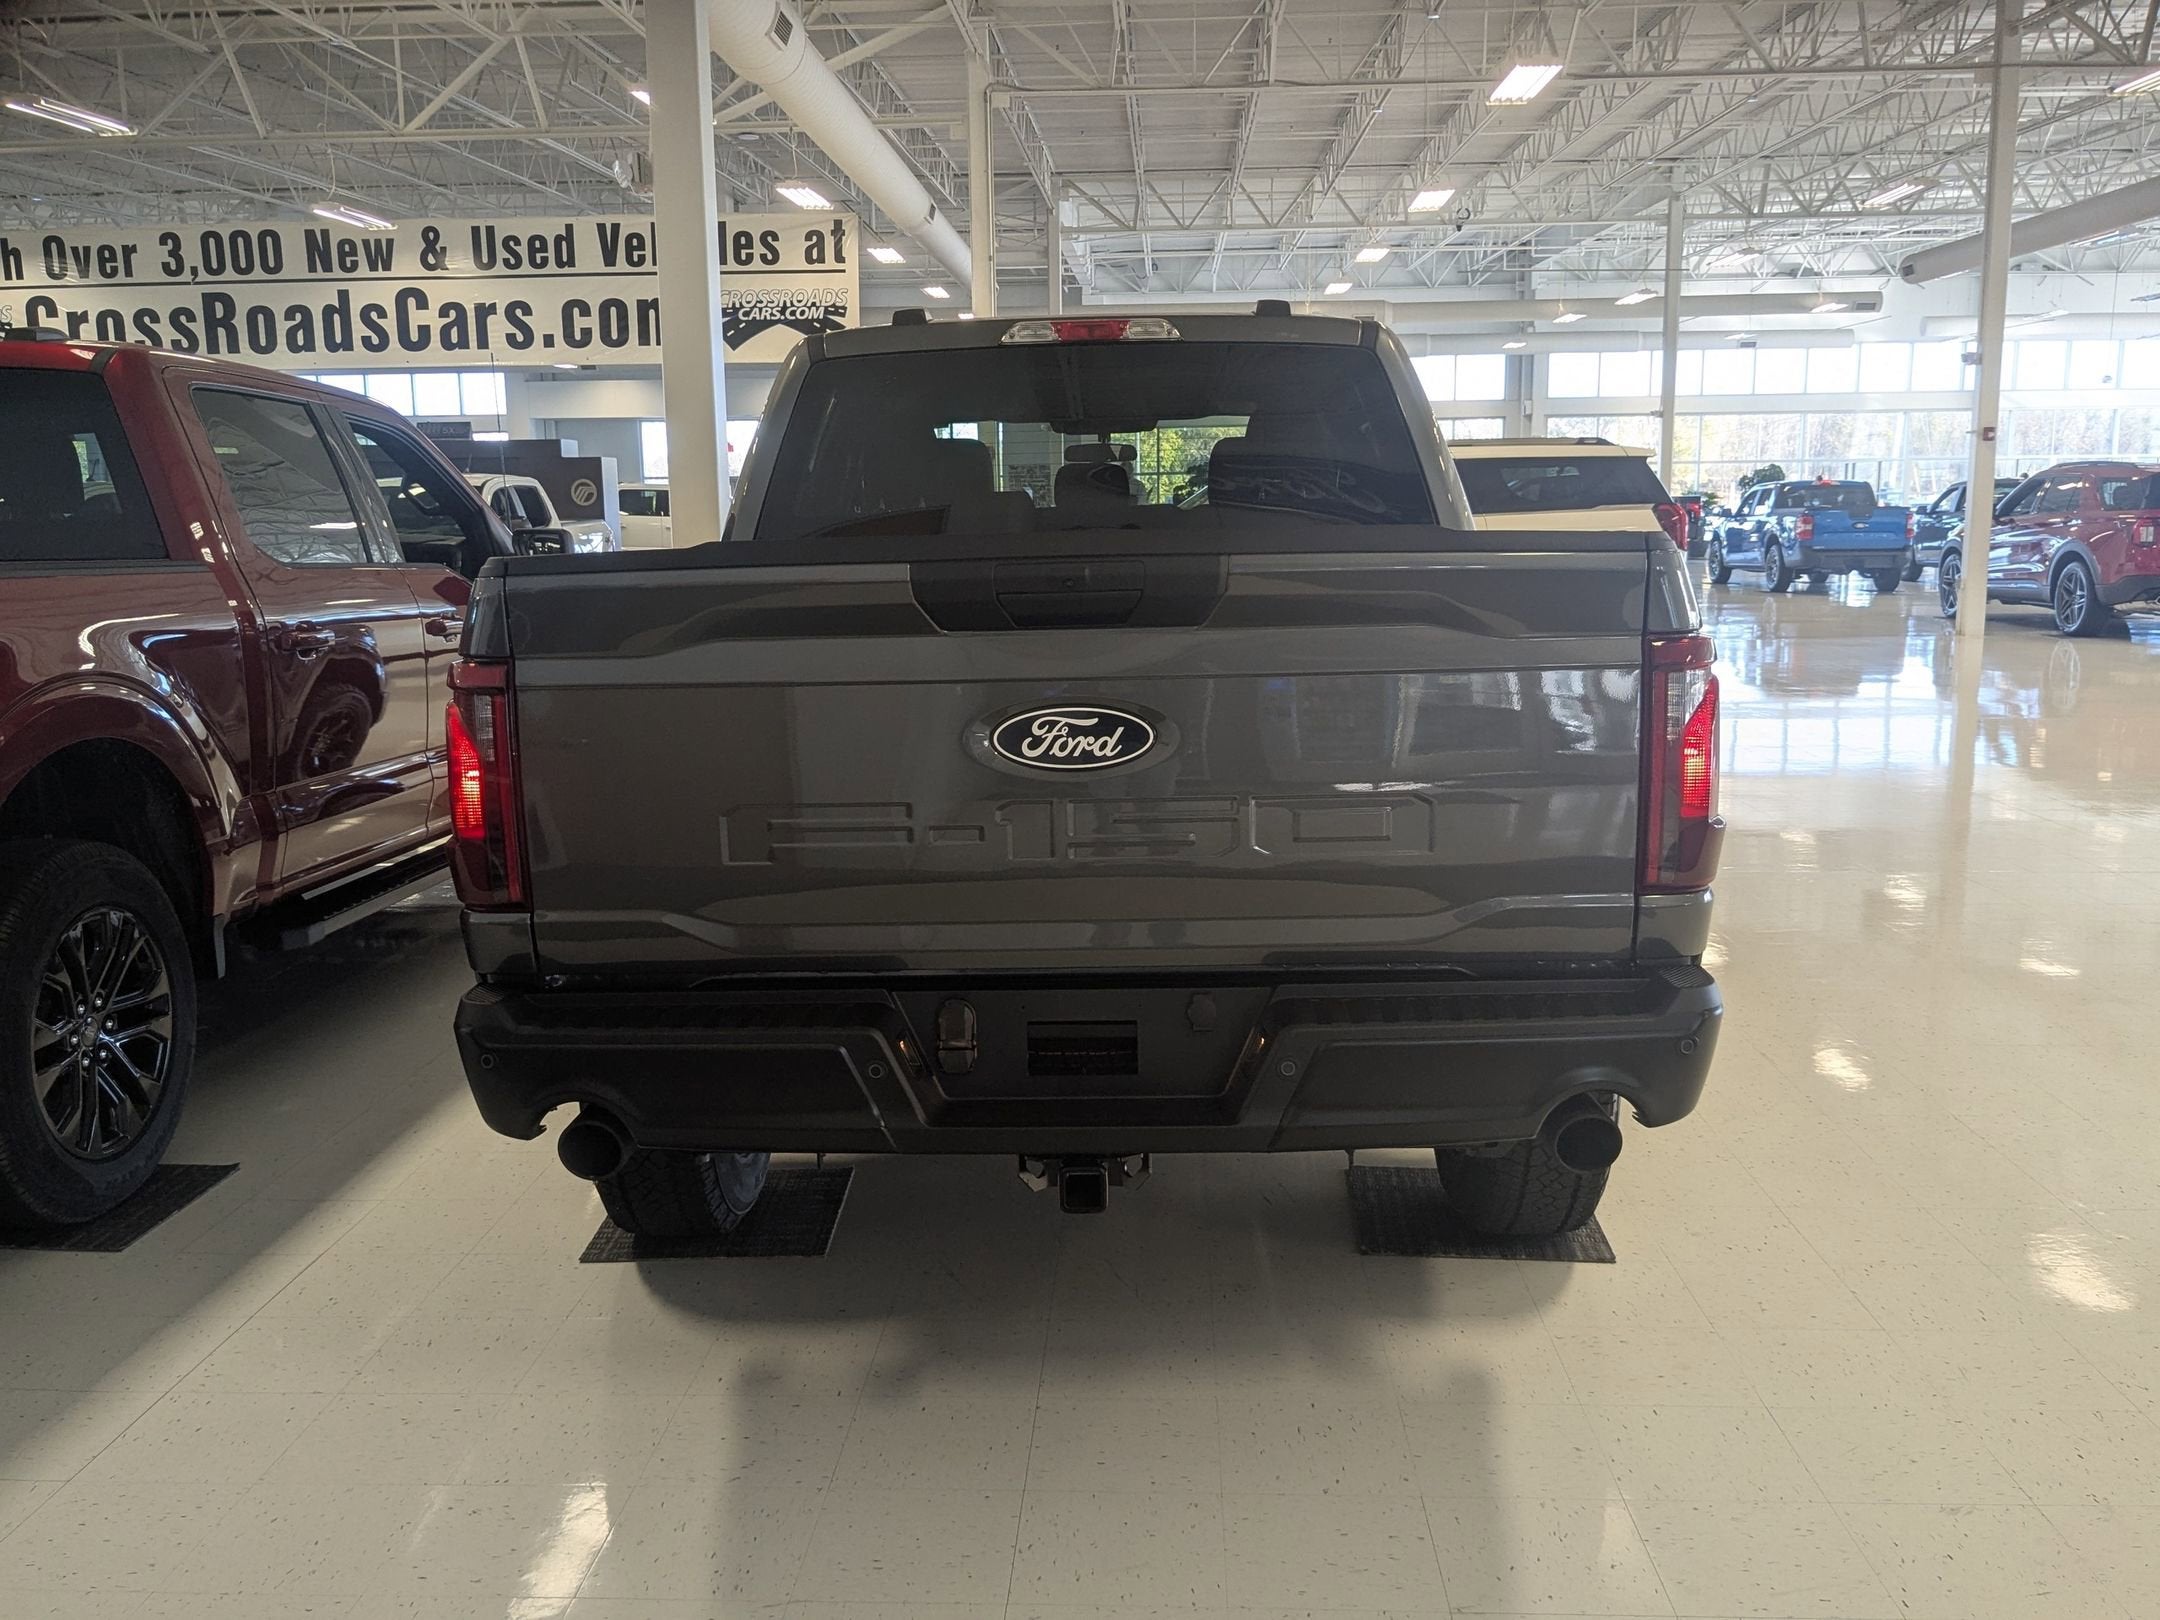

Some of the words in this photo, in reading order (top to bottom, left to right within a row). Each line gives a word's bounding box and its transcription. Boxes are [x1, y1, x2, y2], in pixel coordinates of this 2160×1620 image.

[42, 234, 138, 281] Over
[159, 228, 283, 285] 3,000
[304, 228, 395, 274] New
[419, 225, 450, 273] &
[470, 222, 577, 271] Used
[803, 218, 846, 266] at
[720, 288, 848, 308] CROSSROADS
[738, 306, 825, 320] CARS.COM
[1021, 716, 1124, 758] Ford
[720, 794, 1438, 865] F-150
